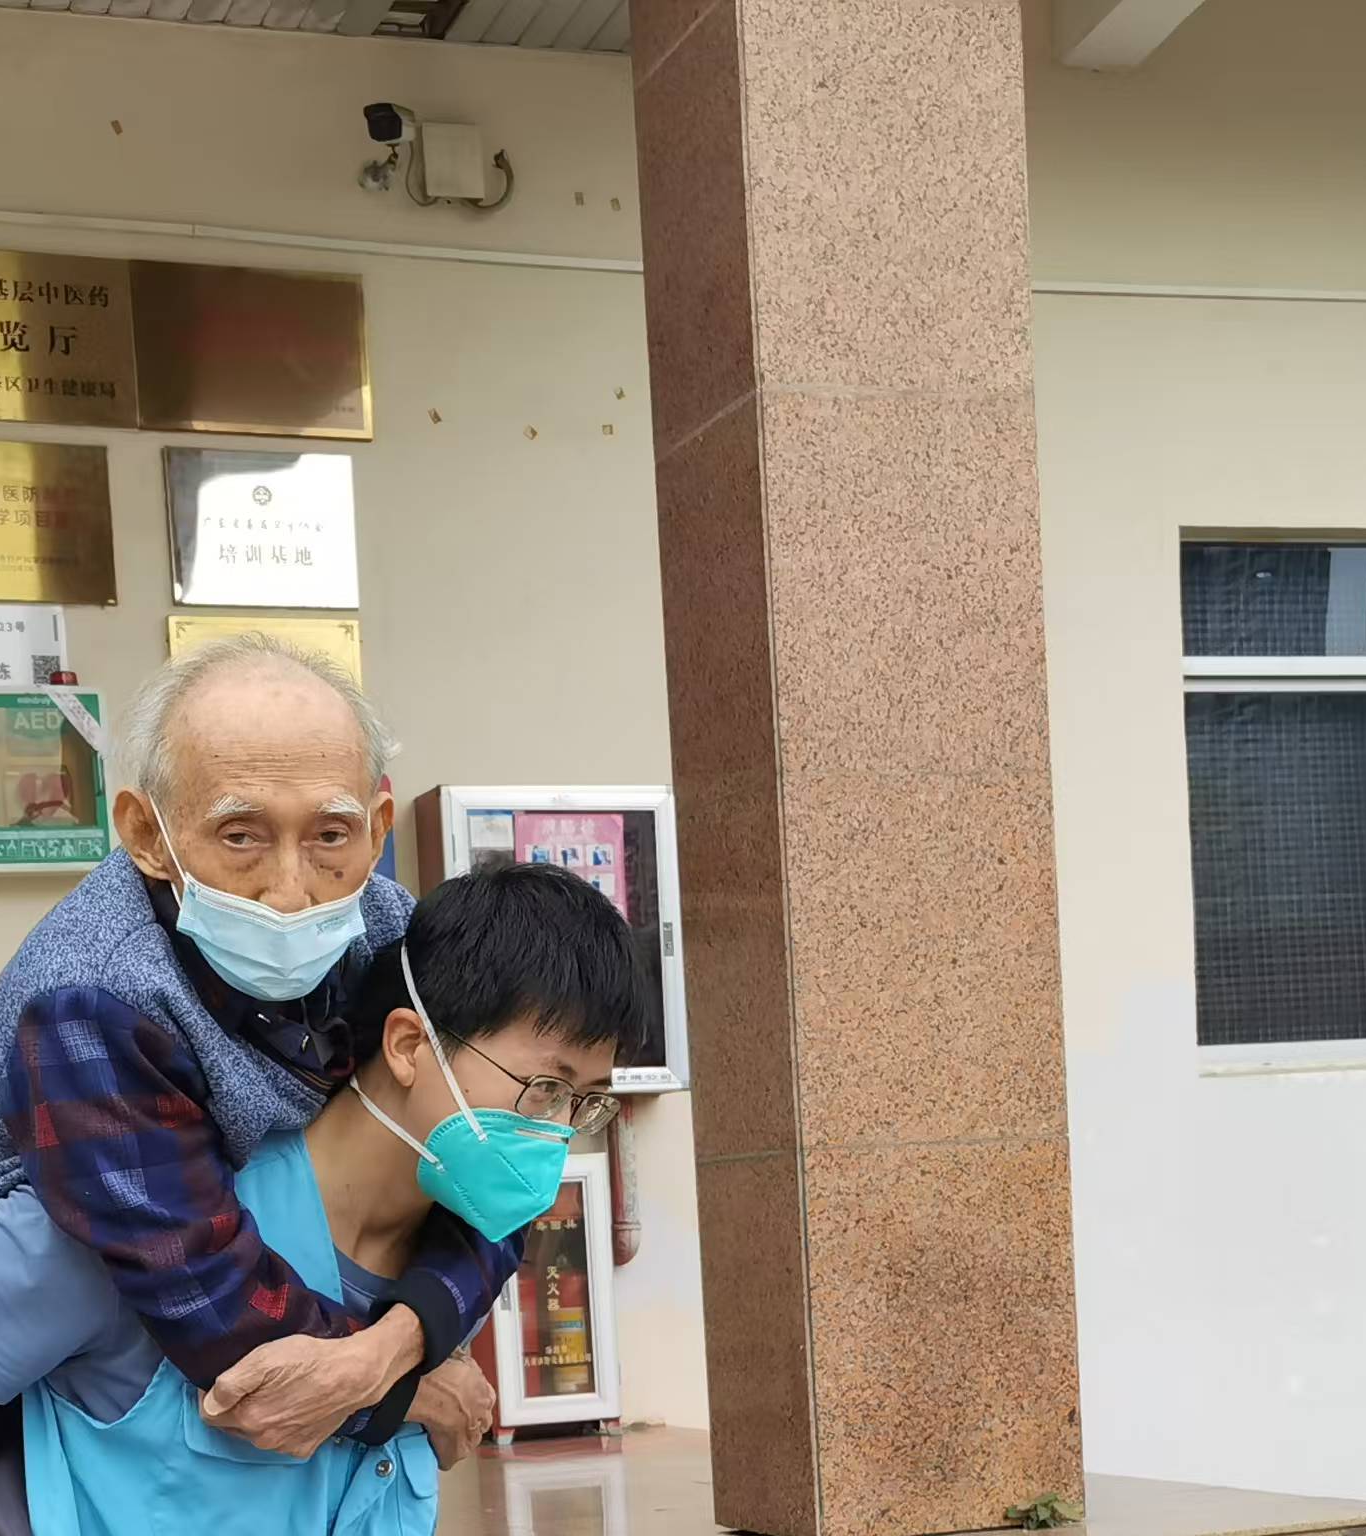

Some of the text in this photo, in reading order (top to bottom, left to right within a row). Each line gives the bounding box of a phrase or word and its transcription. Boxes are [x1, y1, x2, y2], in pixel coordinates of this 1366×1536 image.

[13, 711, 62, 730] AED
[546, 1265, 561, 1312] 灭火器
